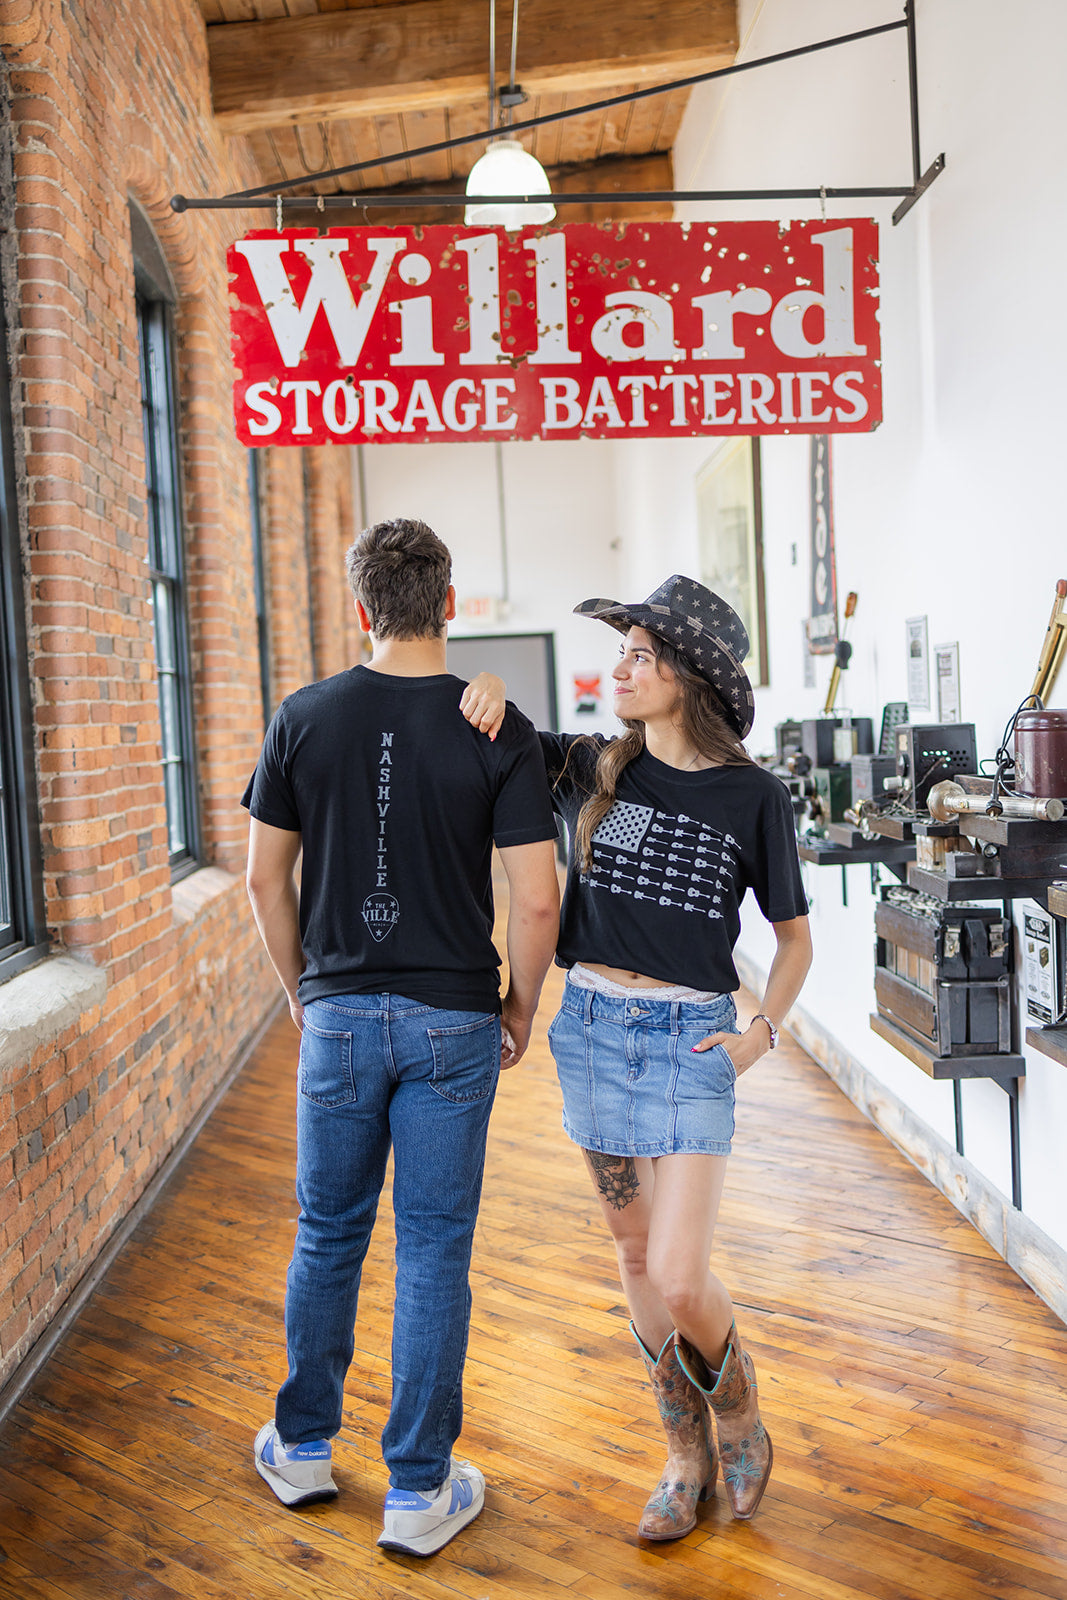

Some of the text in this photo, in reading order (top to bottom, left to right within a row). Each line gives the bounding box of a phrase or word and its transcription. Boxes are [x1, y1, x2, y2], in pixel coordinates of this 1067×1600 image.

[236, 228, 867, 367] Willard
[245, 371, 869, 436] STORAGE BATTERIES
[376, 732, 394, 887] NASHVILLE
[361, 909, 400, 924] VILLE
